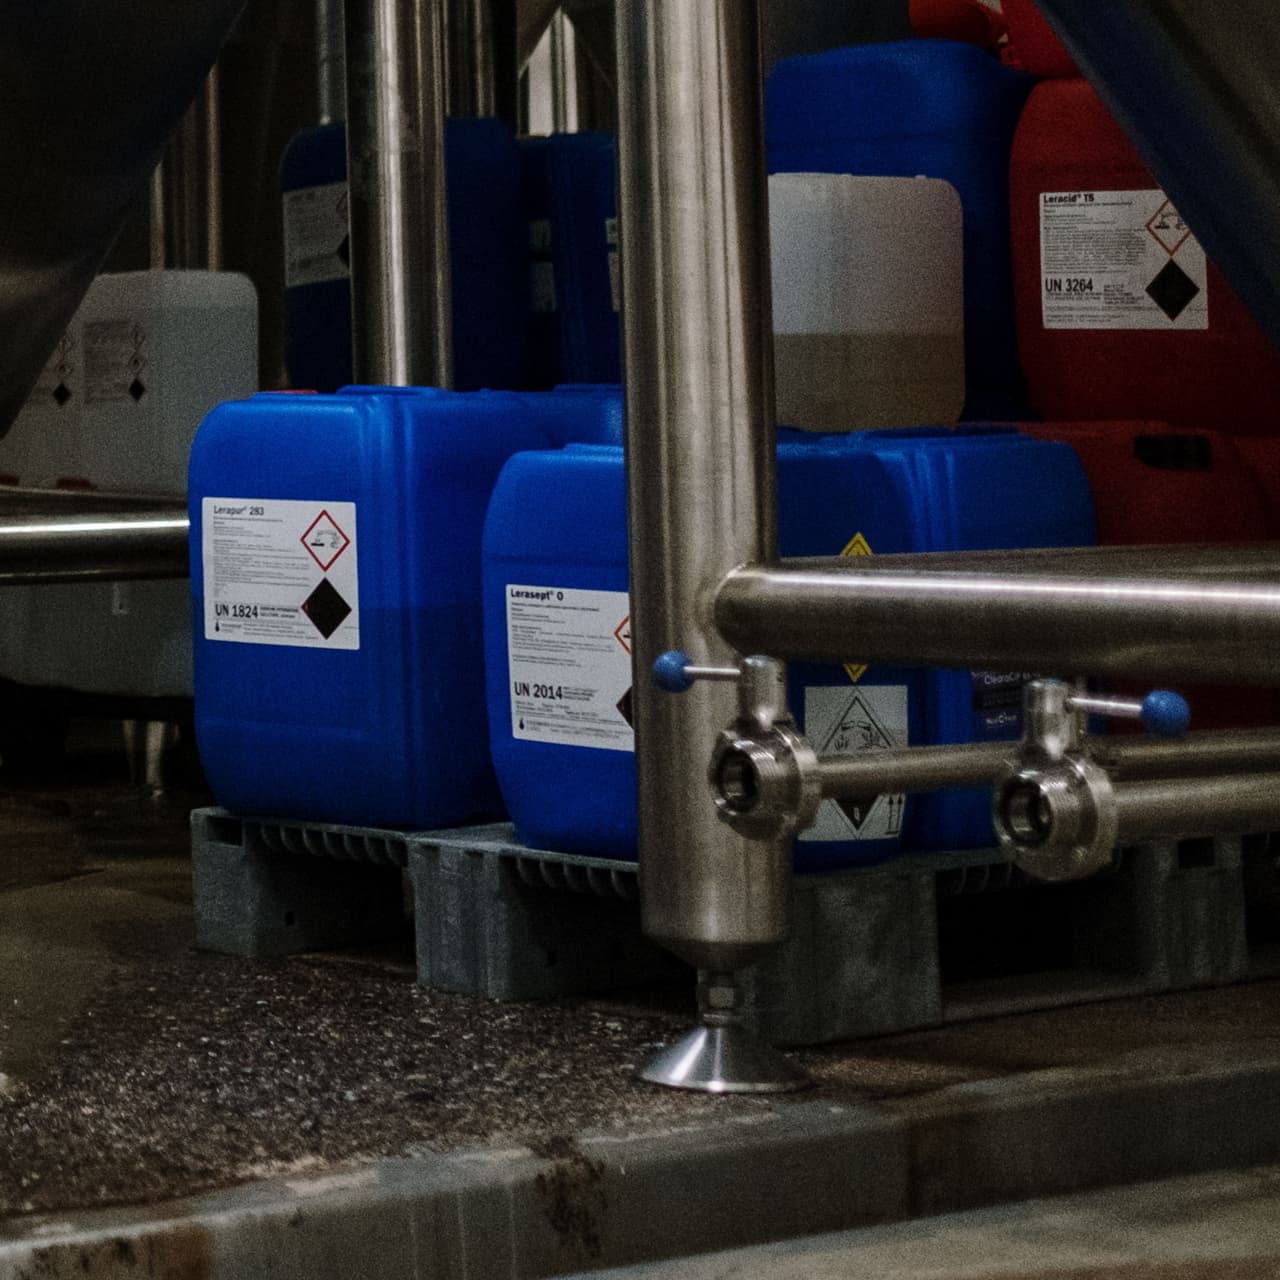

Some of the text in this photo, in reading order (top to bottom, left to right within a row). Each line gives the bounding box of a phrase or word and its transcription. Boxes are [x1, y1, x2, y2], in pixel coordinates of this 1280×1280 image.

[1045, 278, 1093, 292] UN 3264
[215, 604, 229, 617] UN
[232, 604, 259, 619] 1824
[514, 681, 530, 697] UN
[533, 684, 563, 700] 2014
